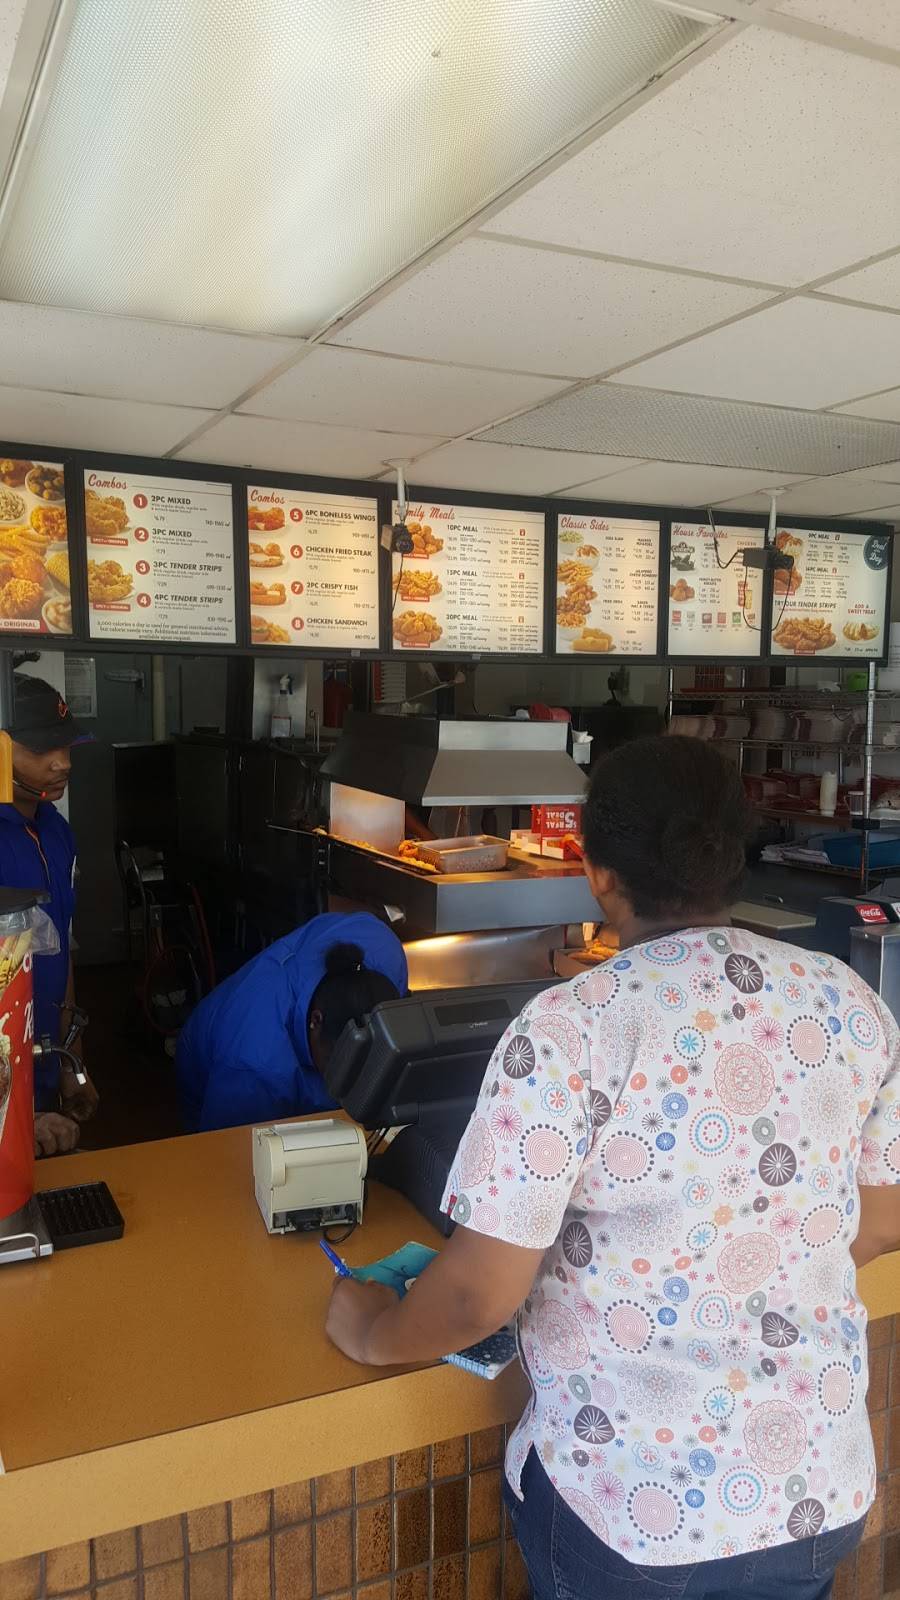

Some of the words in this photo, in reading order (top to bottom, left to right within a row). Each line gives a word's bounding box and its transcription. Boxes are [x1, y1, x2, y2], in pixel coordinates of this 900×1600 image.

[88, 474, 128, 490] Combos
[168, 496, 191, 505] MIXED
[250, 490, 286, 504] Combos
[320, 510, 351, 520] BONELESS
[354, 514, 376, 522] WINGS
[430, 506, 456, 520] Meals
[560, 516, 587, 529] Classic
[589, 518, 609, 531] Sides
[152, 528, 166, 536] 3PC
[168, 529, 192, 538] MIXED
[672, 525, 694, 537] House
[306, 546, 334, 554] CHICKEN
[336, 548, 353, 556] FRIED
[353, 549, 372, 557] STEAK
[869, 553, 882, 565] Day
[170, 562, 196, 571] TENDER
[199, 564, 222, 572] STRIPS
[170, 594, 198, 602] TENDER
